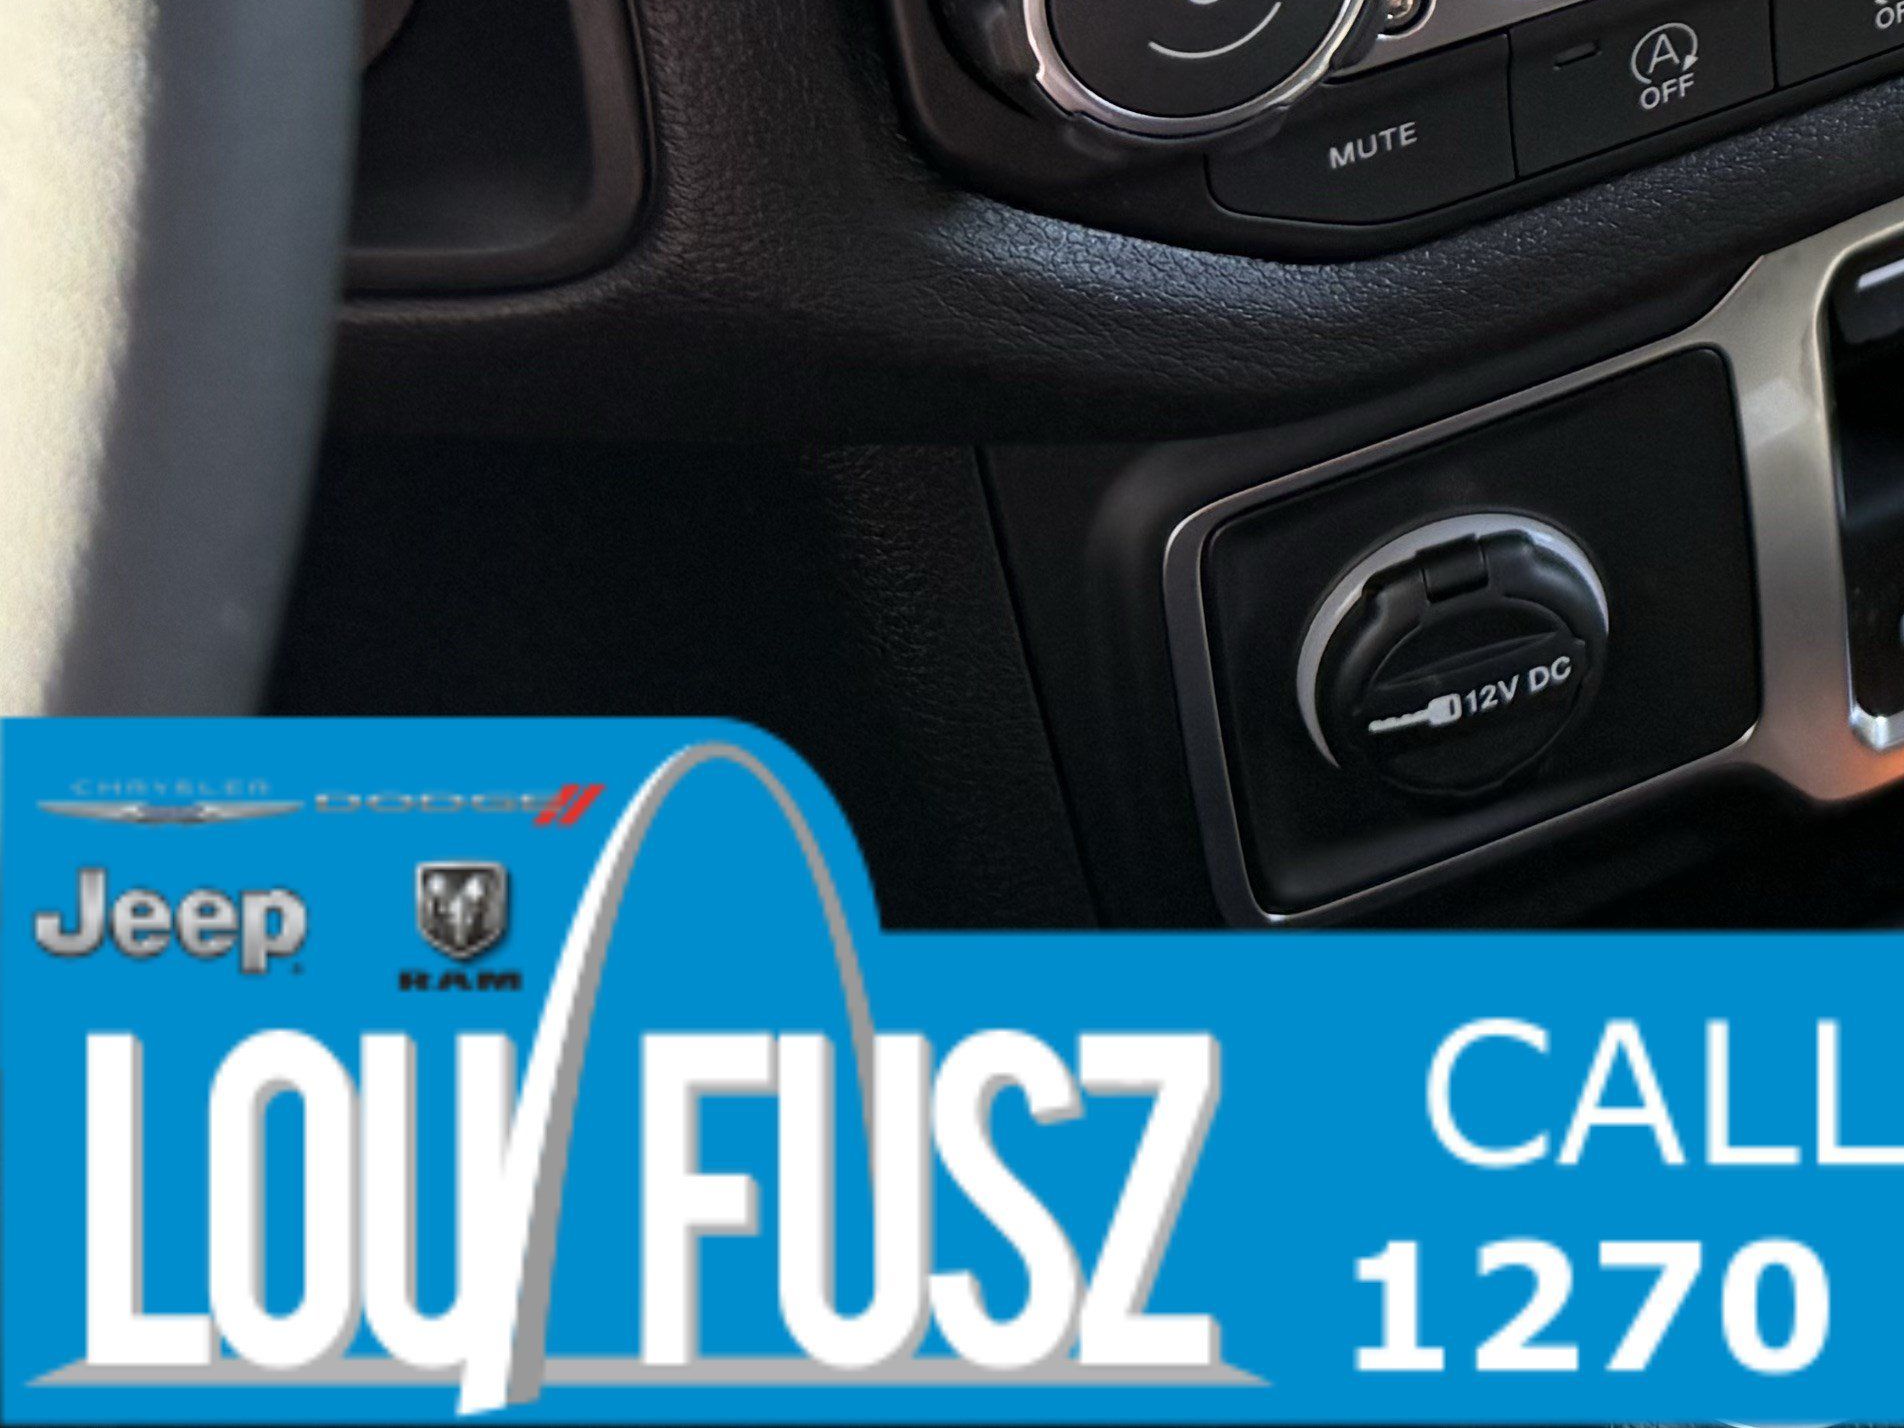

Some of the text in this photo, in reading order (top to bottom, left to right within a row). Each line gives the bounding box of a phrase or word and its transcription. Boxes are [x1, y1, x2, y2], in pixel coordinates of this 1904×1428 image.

[1639, 74, 1695, 112] OFF
[1329, 121, 1419, 170] MUTE
[1466, 655, 1572, 715] 12V DC
